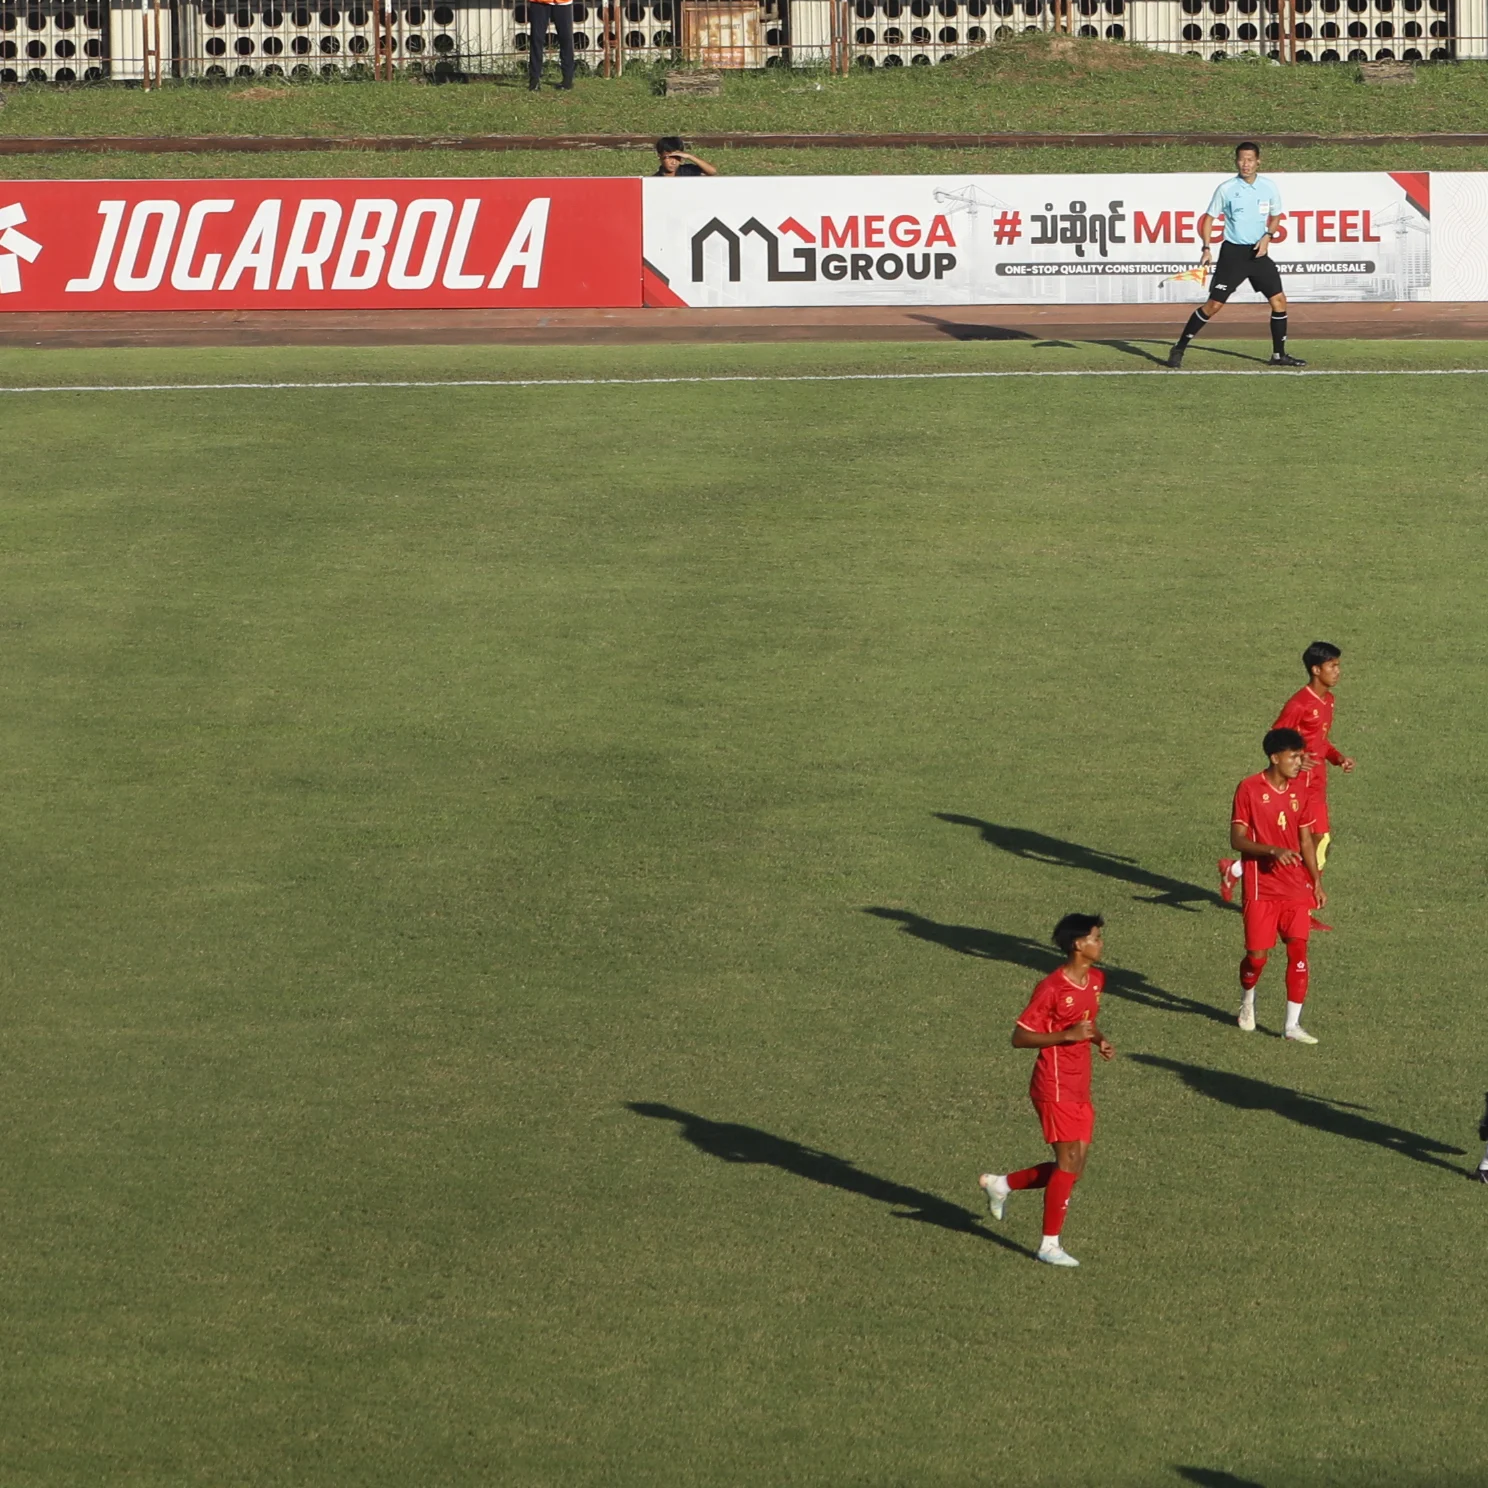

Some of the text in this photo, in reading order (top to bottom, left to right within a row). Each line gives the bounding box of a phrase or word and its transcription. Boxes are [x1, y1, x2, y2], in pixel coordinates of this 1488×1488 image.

[822, 214, 957, 249] MEGA
[1134, 211, 1225, 244] MEG
[65, 197, 551, 292] JOGARBOLA
[822, 252, 957, 281] GROUP
[1005, 265, 1058, 275] ONE-STOP
[1061, 264, 1103, 275] QUALITY
[1105, 264, 1187, 274] CONSTRUCTION
[1296, 263, 1305, 273] &
[1306, 263, 1367, 273] WHOLESALE
[1277, 810, 1287, 832] 4
